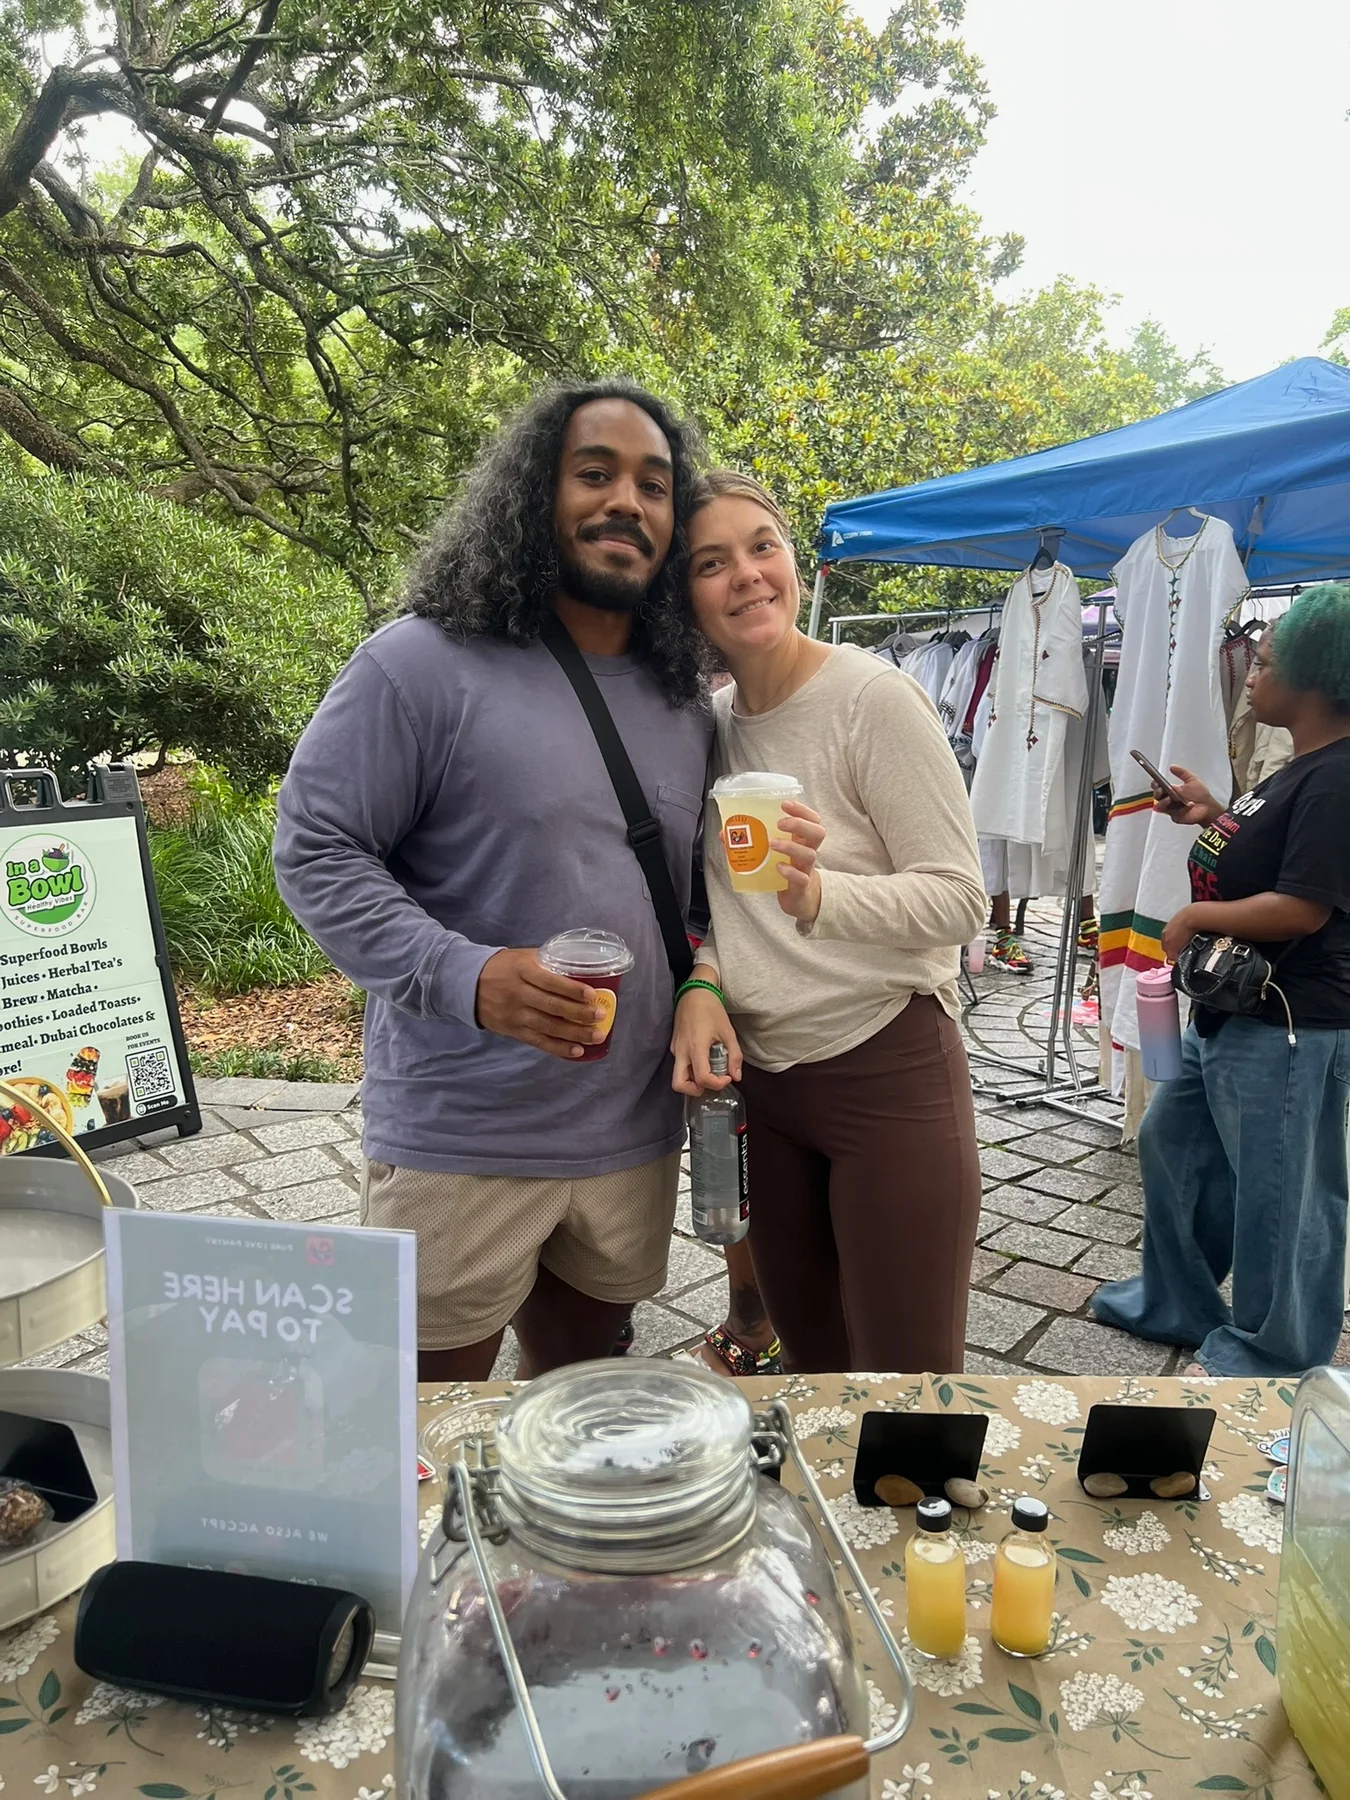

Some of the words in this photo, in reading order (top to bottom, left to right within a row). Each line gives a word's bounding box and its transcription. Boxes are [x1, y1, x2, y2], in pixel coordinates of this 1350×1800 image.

[1209, 831, 1229, 851] Day
[6, 861, 27, 877] In
[28, 859, 40, 873] a
[7, 865, 84, 906] Bowl
[27, 901, 52, 911] Healthy
[54, 896, 73, 904] Vibes
[14, 915, 73, 932] SUPERFOOD
[76, 901, 88, 918] BAR
[0, 944, 69, 967] Superfood
[70, 938, 108, 954] Bowls
[0, 973, 40, 990] Juices
[48, 961, 91, 979] Herbal
[92, 957, 123, 972] Tea's
[2, 994, 38, 1009] Brew
[46, 983, 92, 1001] Matcha
[51, 1004, 97, 1021] Loaded
[40, 1026, 78, 1045] Dubai
[79, 1014, 144, 1036] Chocolates
[145, 1010, 155, 1022] &
[139, 1038, 161, 1048] EVENTS
[146, 1102, 160, 1110] Scan
